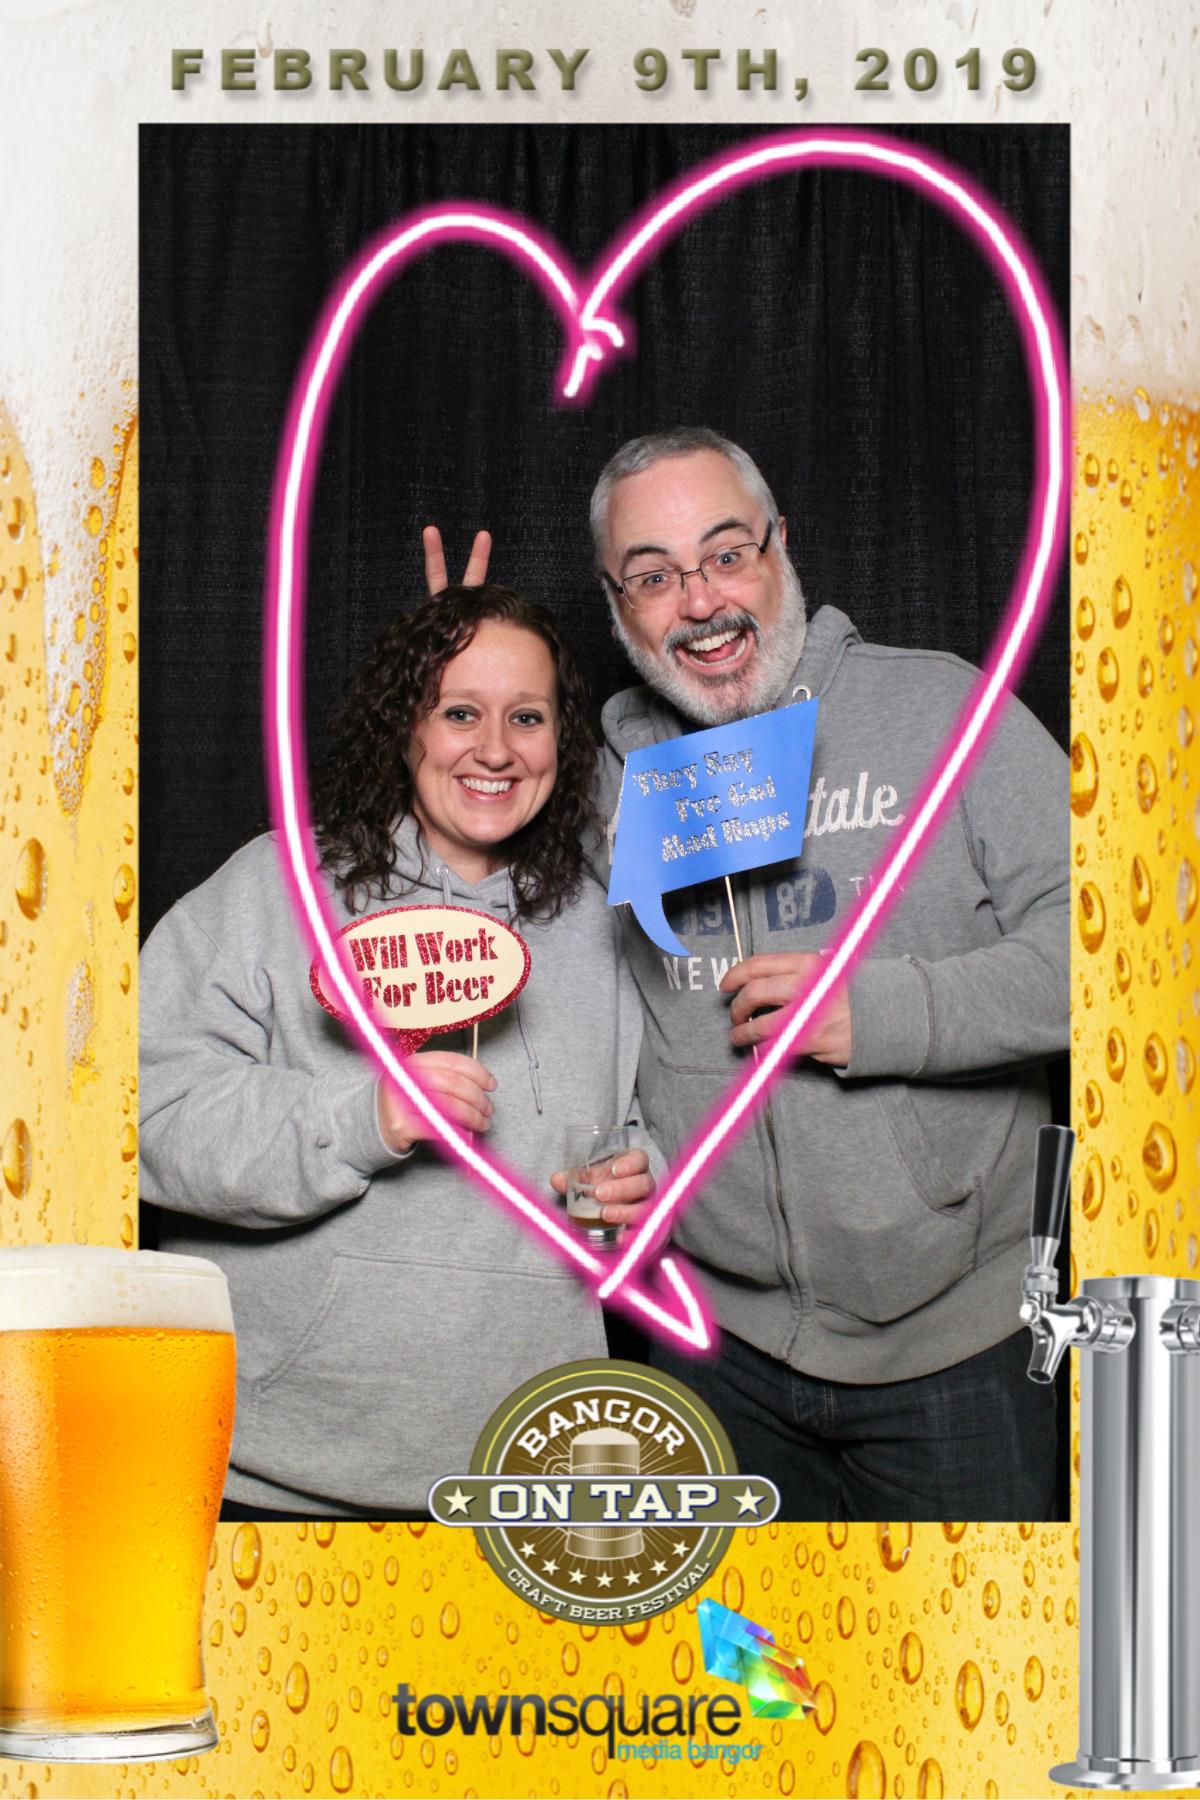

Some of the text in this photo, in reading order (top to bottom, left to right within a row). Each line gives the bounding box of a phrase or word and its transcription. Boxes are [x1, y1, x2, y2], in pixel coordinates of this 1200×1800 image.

[632, 748, 753, 796] They Say
[728, 775, 776, 807] Got
[661, 810, 790, 862] Mad Hops
[774, 872, 819, 922] 87
[349, 928, 498, 972] Will Work
[361, 971, 494, 1008] For Beer
